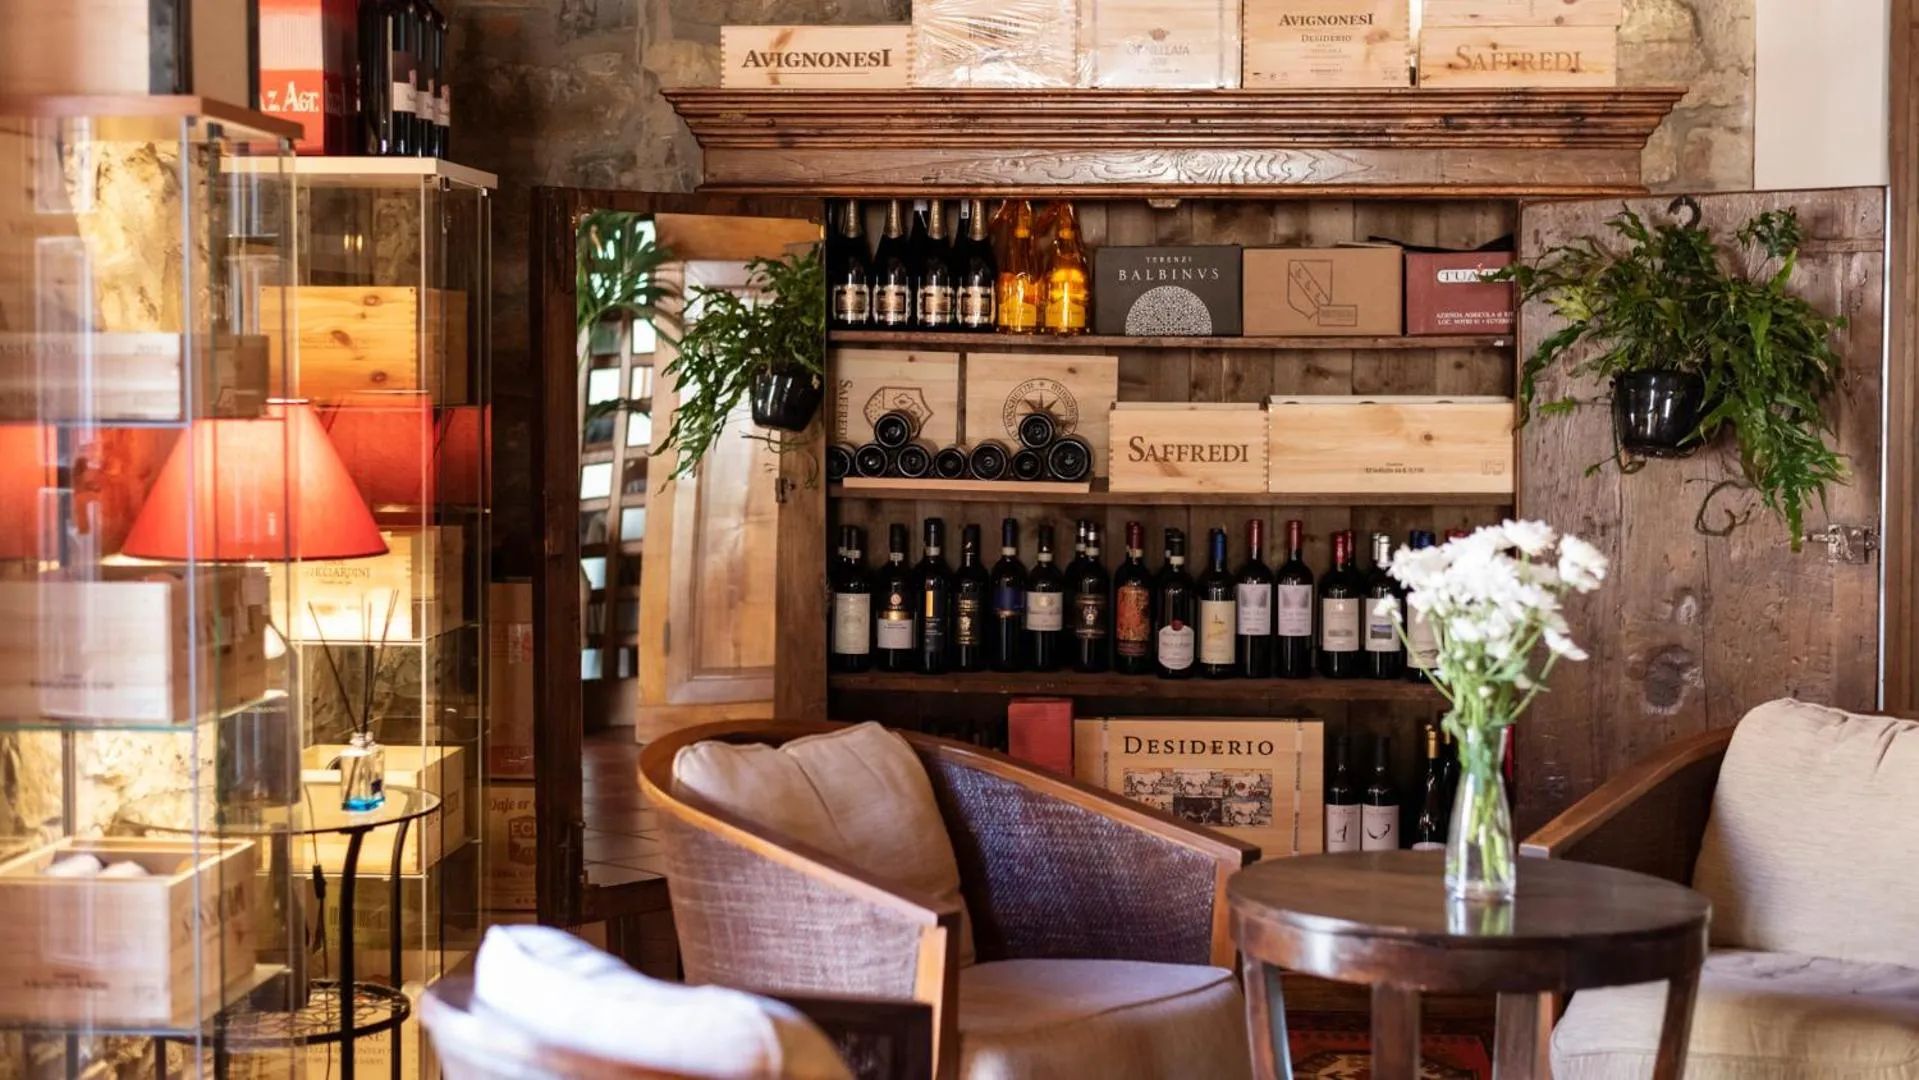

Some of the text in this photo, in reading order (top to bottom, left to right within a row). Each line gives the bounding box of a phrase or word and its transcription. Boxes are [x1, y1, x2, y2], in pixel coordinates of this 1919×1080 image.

[1279, 13, 1375, 27] AVIGNONESI
[741, 49, 893, 68] AVIGNONESI
[1456, 43, 1584, 71] SAFFREDI
[1118, 268, 1220, 281] BALBINVS
[1128, 435, 1249, 463] SAFFREDI
[1123, 735, 1275, 756] DESIDERIO
